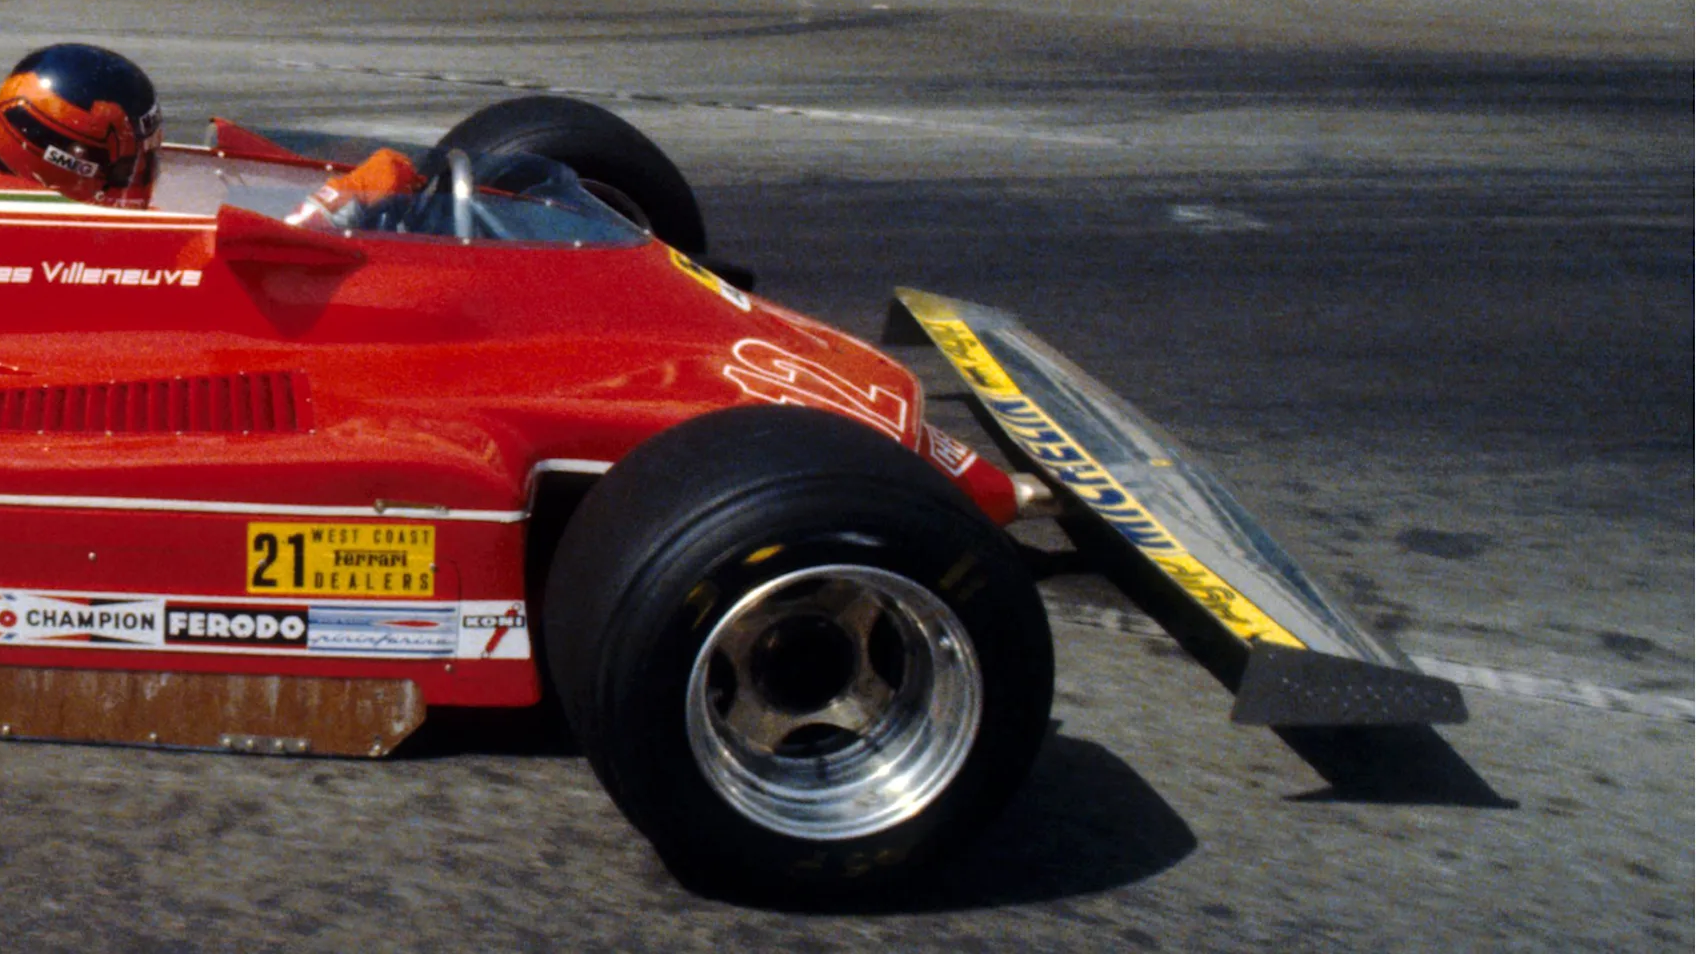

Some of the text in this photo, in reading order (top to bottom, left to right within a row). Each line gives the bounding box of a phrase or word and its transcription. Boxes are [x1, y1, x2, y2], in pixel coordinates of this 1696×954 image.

[41, 260, 203, 287] Villeneuve
[721, 337, 909, 444] 12
[987, 398, 1178, 555] MICHELIN
[311, 528, 431, 545] WEST COAST
[252, 532, 305, 589] 21
[333, 549, 408, 568] Ferrari
[313, 572, 430, 592] DEALERS
[25, 608, 156, 632] CHAMPION
[167, 610, 306, 641] FERODO
